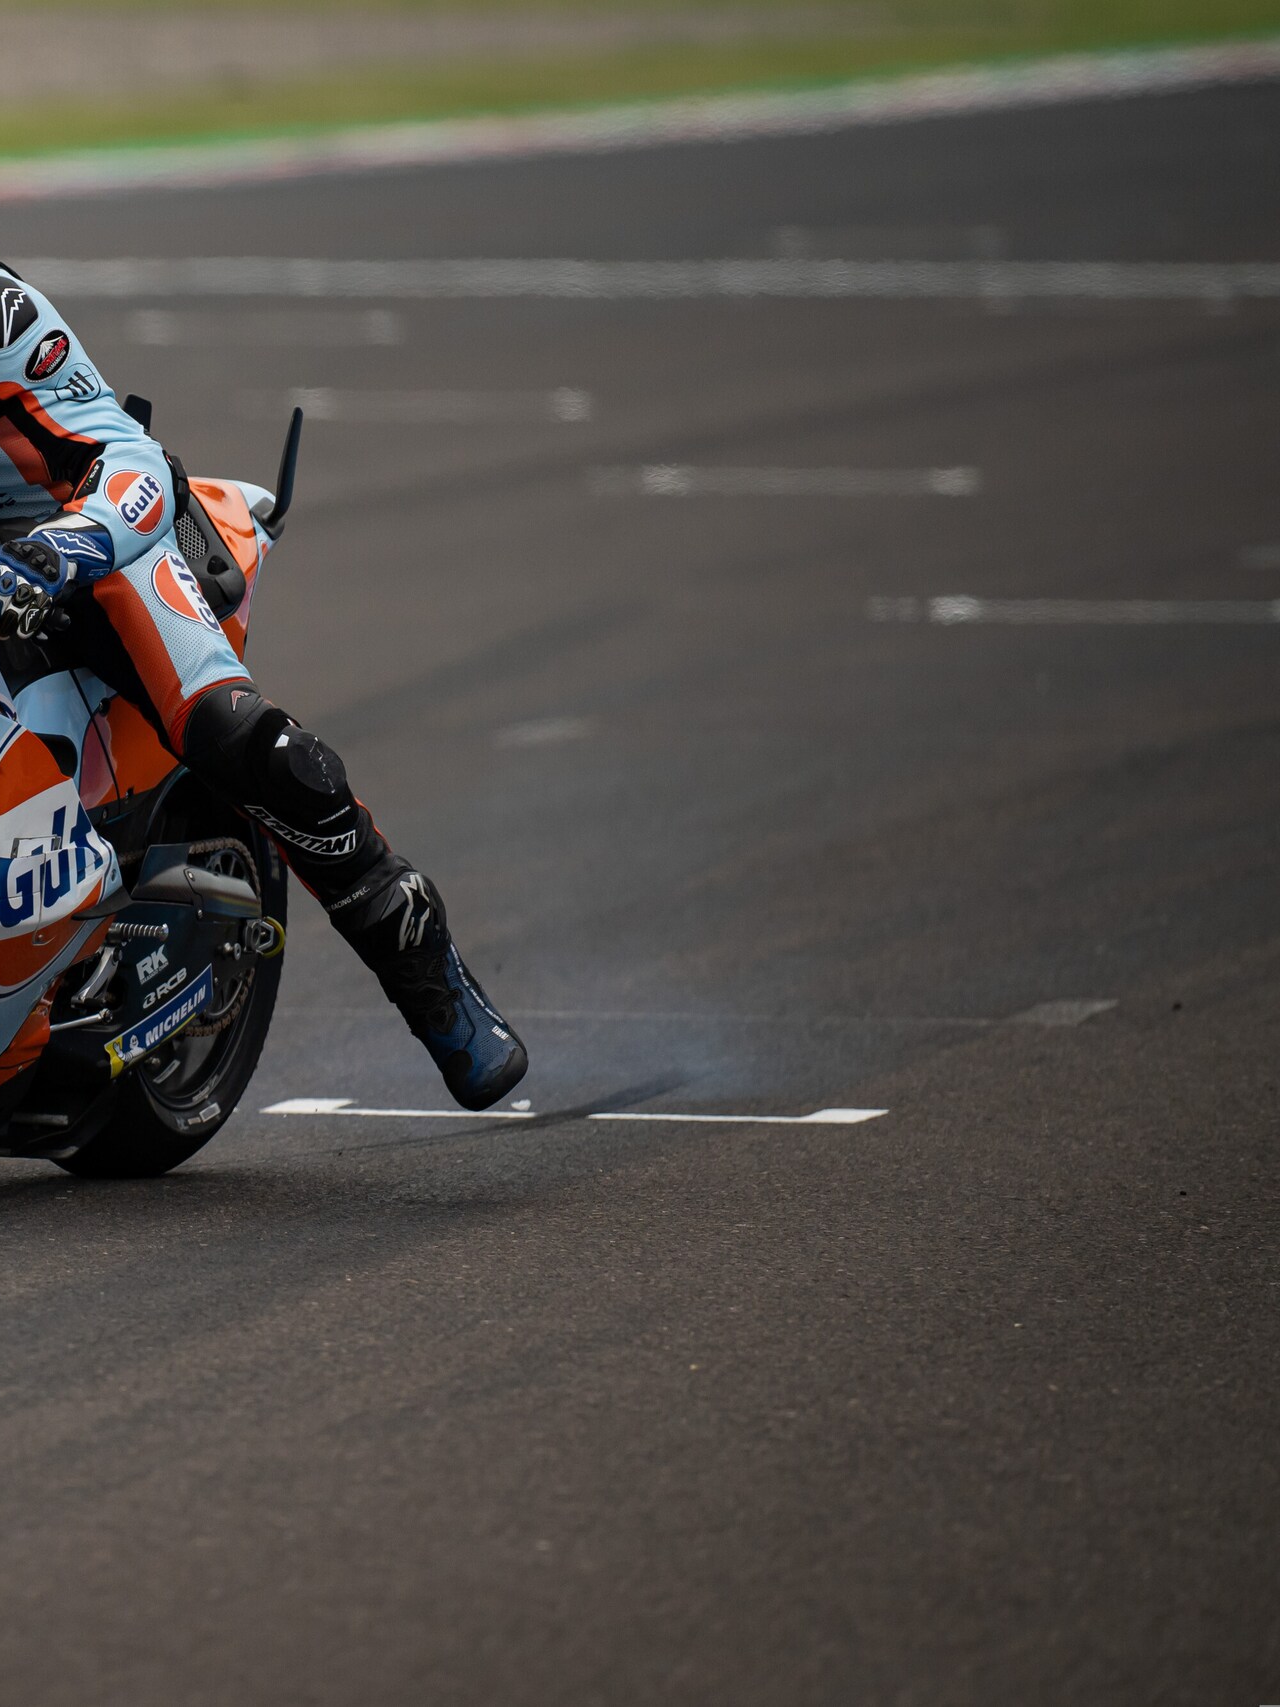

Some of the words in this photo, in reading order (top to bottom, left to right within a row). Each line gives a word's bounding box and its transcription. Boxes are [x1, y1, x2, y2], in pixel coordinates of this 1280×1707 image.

[121, 475, 160, 524] Gulf
[136, 944, 168, 981] RK
[145, 984, 206, 1047] MICHELIN
